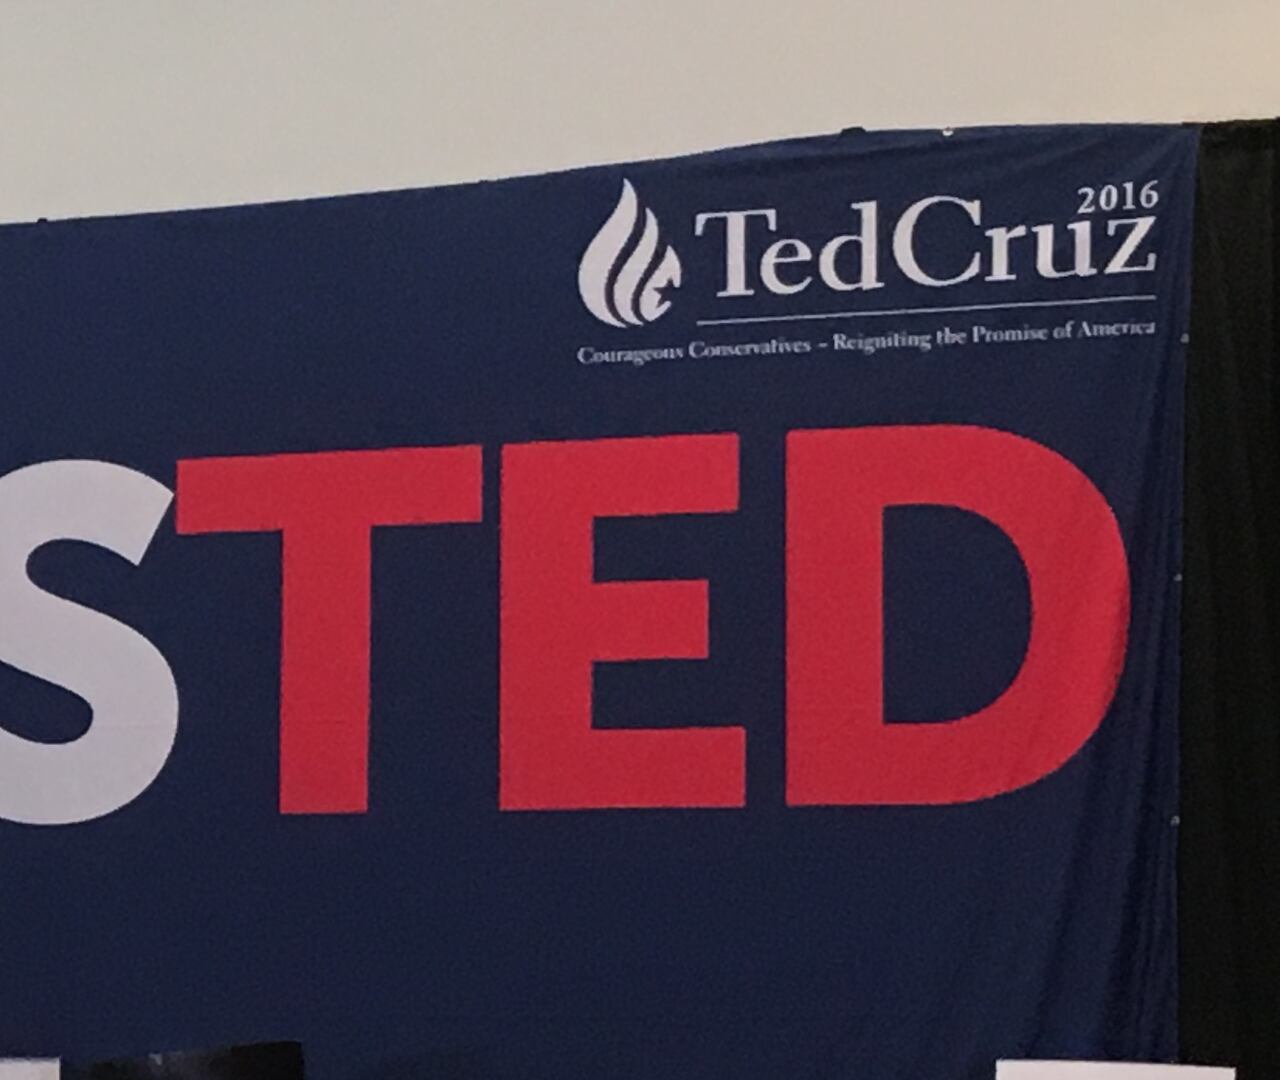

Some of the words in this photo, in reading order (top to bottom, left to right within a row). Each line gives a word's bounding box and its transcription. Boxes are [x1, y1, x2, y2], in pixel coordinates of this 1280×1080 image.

[1076, 179, 1159, 214] 2016
[694, 195, 1158, 298] TedCruz
[576, 346, 684, 367] Courageous
[687, 336, 812, 359] Conservatives
[832, 332, 933, 356] Reigniting
[936, 326, 967, 345] the
[972, 325, 1049, 343] Promise
[1053, 320, 1076, 339] of
[1078, 320, 1156, 338] America
